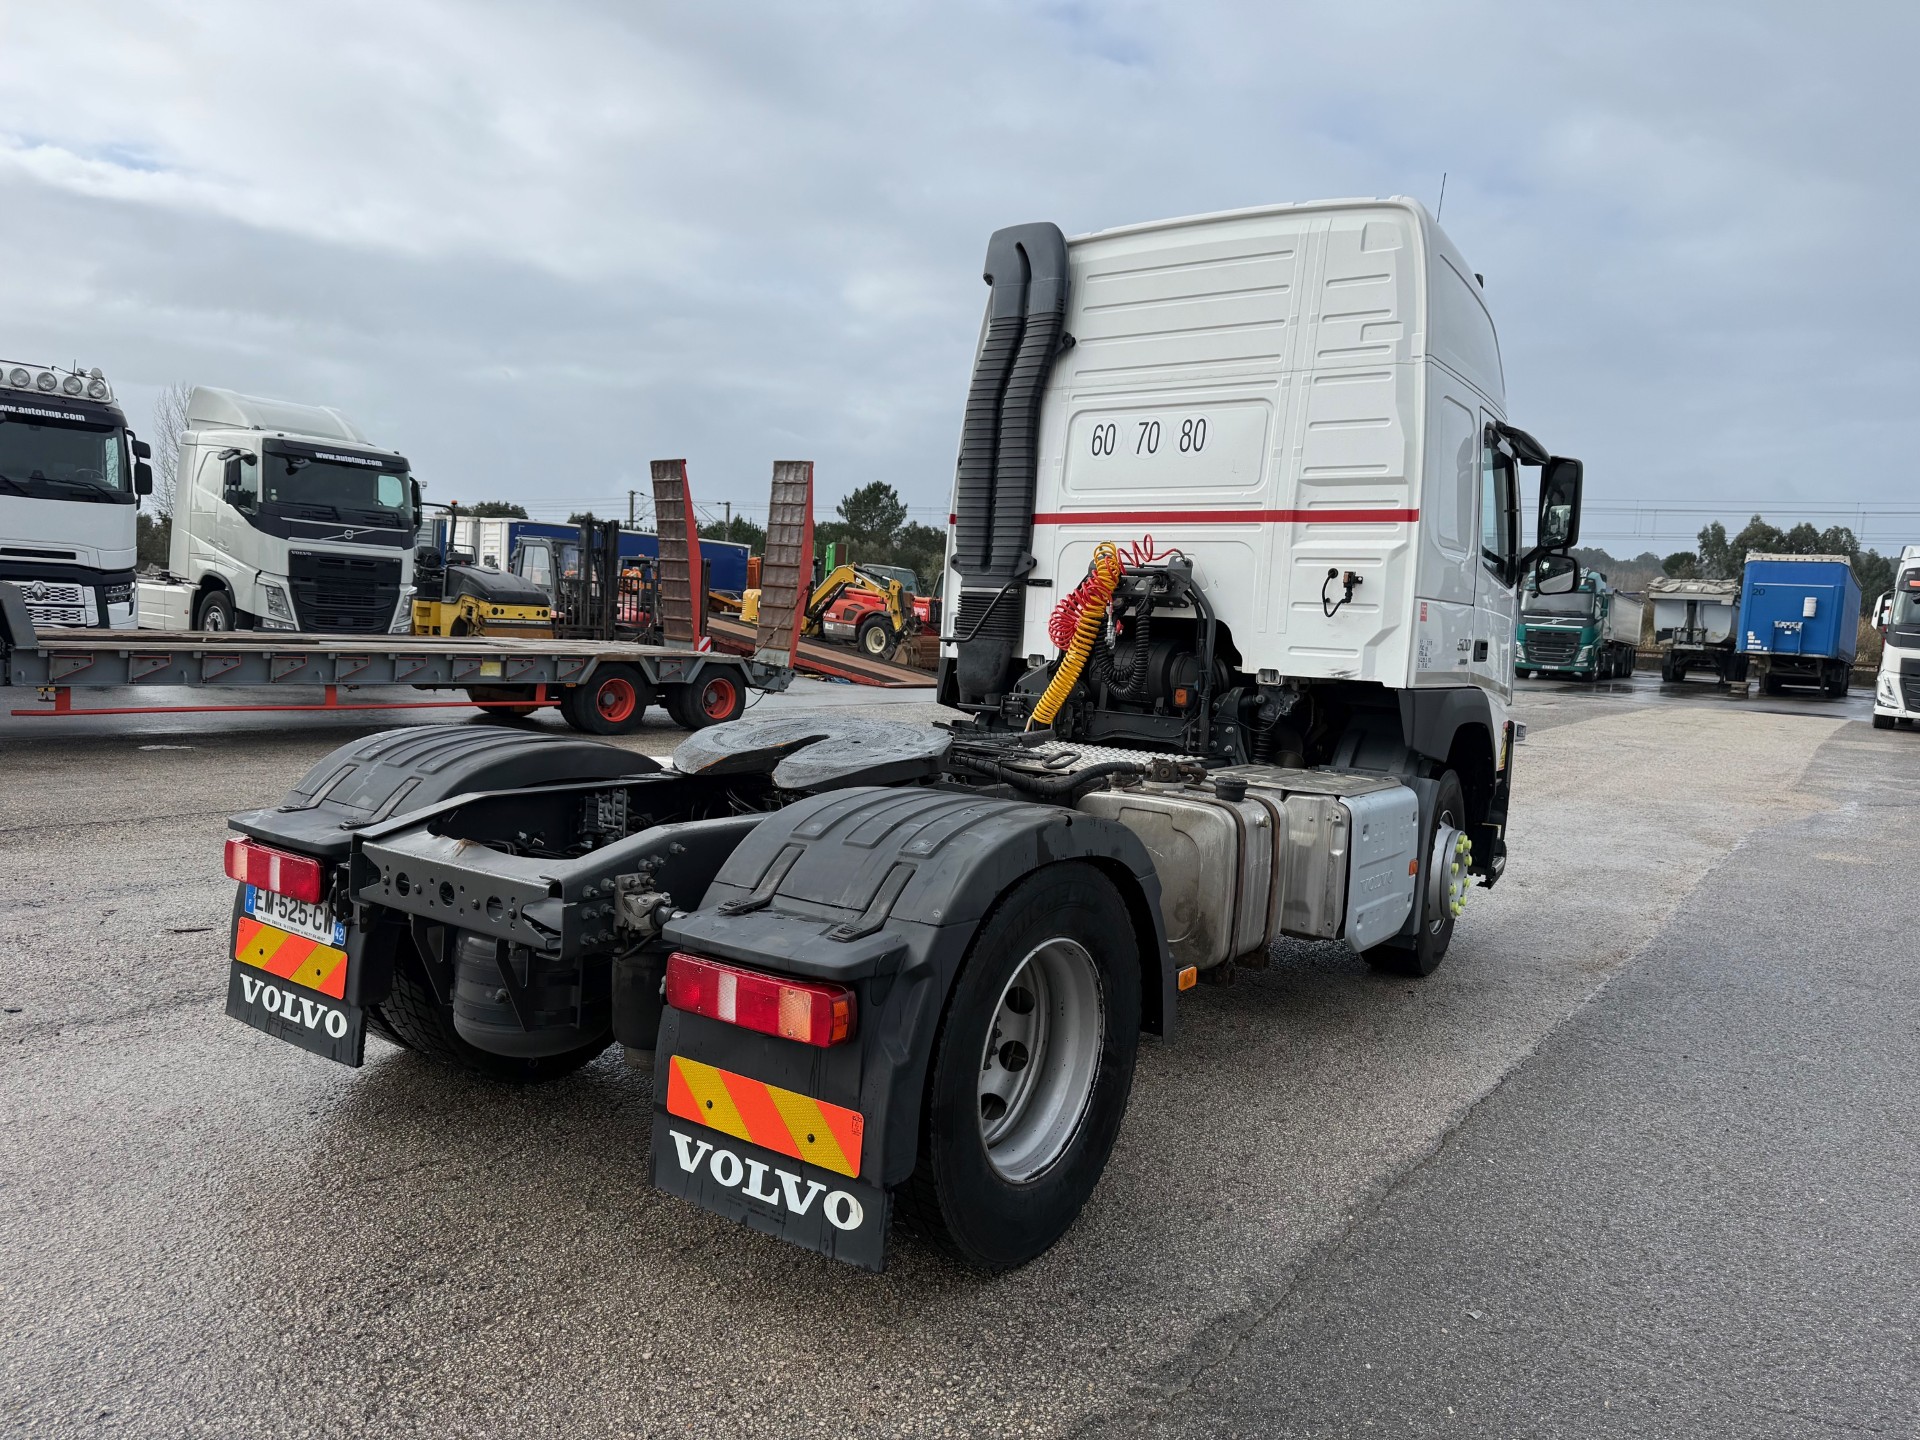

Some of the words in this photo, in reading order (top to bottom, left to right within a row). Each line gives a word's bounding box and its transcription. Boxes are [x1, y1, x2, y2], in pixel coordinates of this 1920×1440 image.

[1091, 423, 1116, 456] 60
[1136, 421, 1160, 454] 70
[1179, 418, 1207, 453] 80
[315, 452, 383, 467] www.autotmp.com
[1752, 588, 1766, 596] 20
[335, 926, 344, 940] 42
[240, 973, 348, 1039] VOLVO
[669, 1129, 864, 1231] VOLVO
